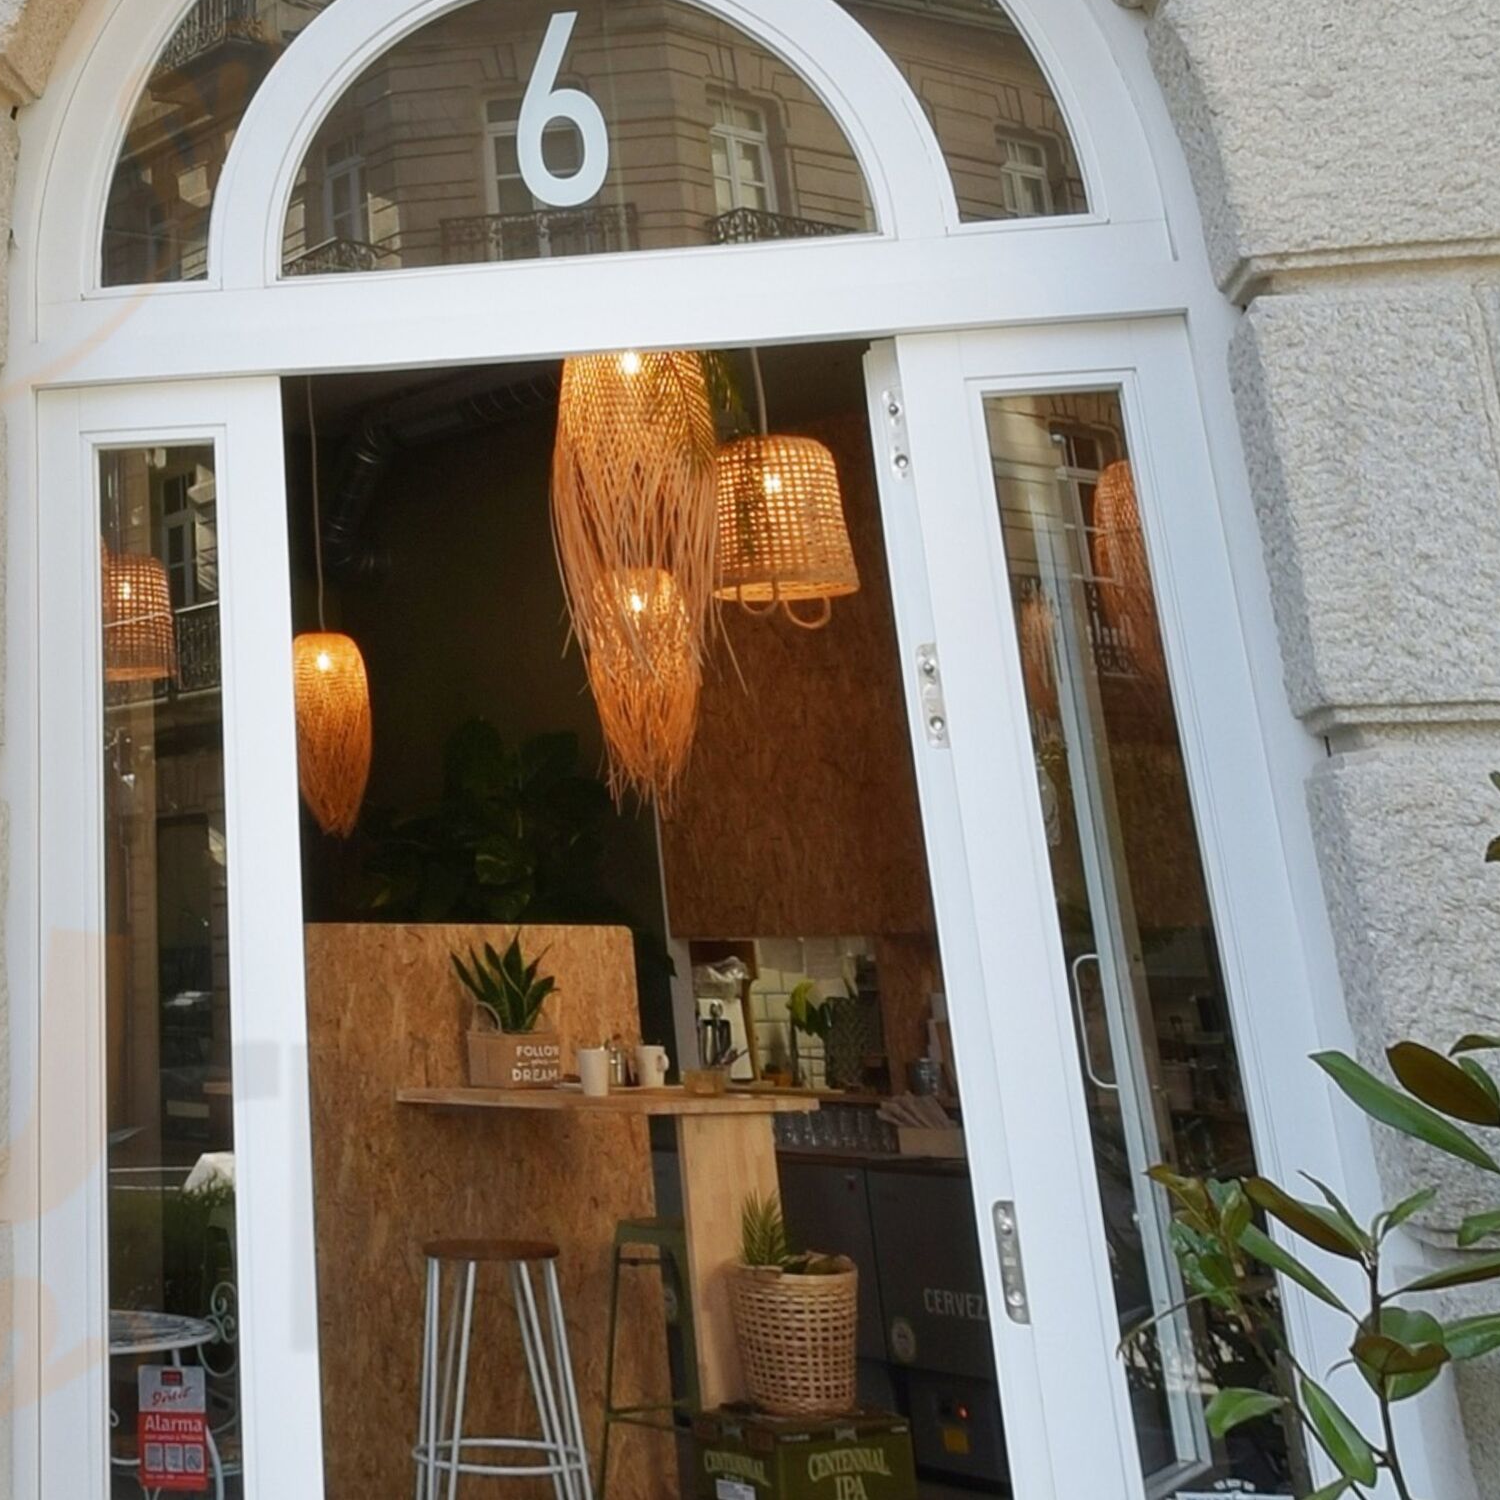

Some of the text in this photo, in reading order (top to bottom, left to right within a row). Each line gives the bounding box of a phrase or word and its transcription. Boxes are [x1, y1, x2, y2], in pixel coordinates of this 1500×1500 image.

[514, 10, 610, 208] 6
[145, 1414, 203, 1433] Alarma
[806, 1447, 892, 1483] CENTENNIAL
[834, 1475, 869, 1500] IPA
